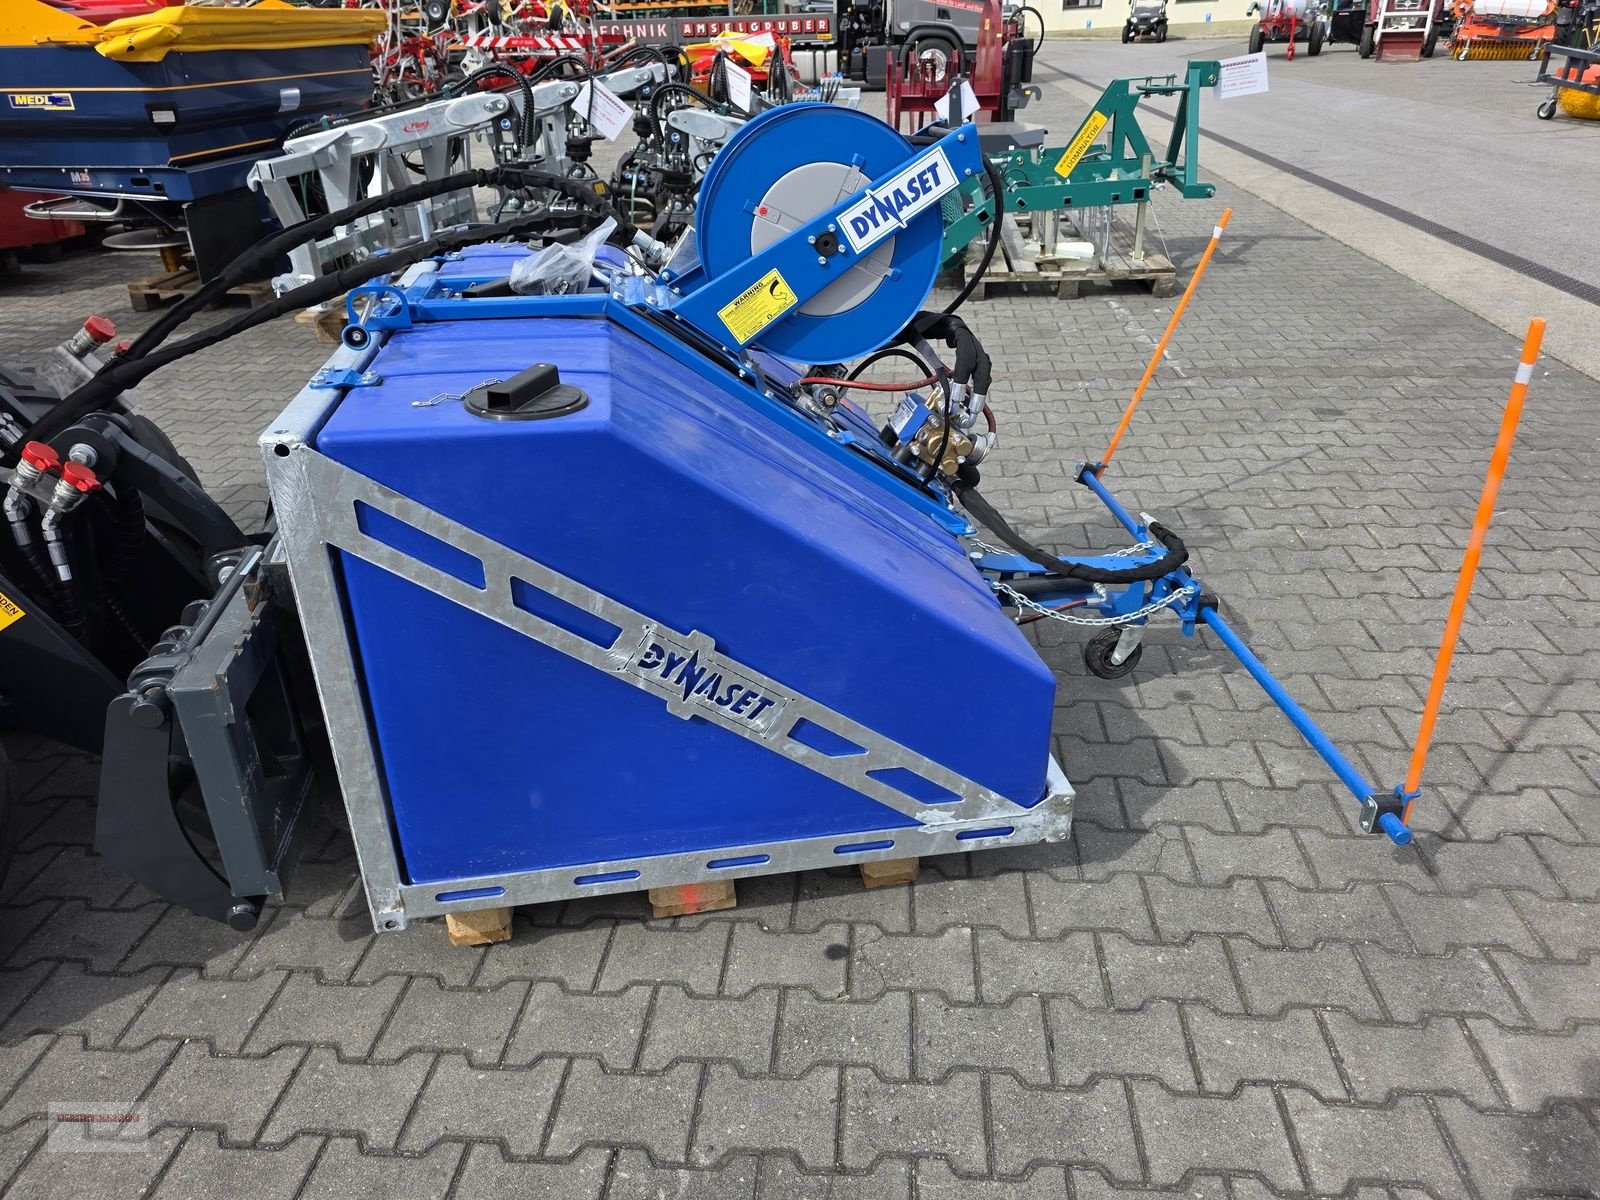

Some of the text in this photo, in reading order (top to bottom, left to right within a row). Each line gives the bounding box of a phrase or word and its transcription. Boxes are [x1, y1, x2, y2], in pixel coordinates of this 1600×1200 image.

[683, 19, 828, 35] AMSELGRUBER
[1066, 124, 1100, 169] DOMINATOR
[849, 161, 942, 240] DYNASET
[733, 282, 764, 307] WARNING
[637, 642, 775, 720] DYNASET
